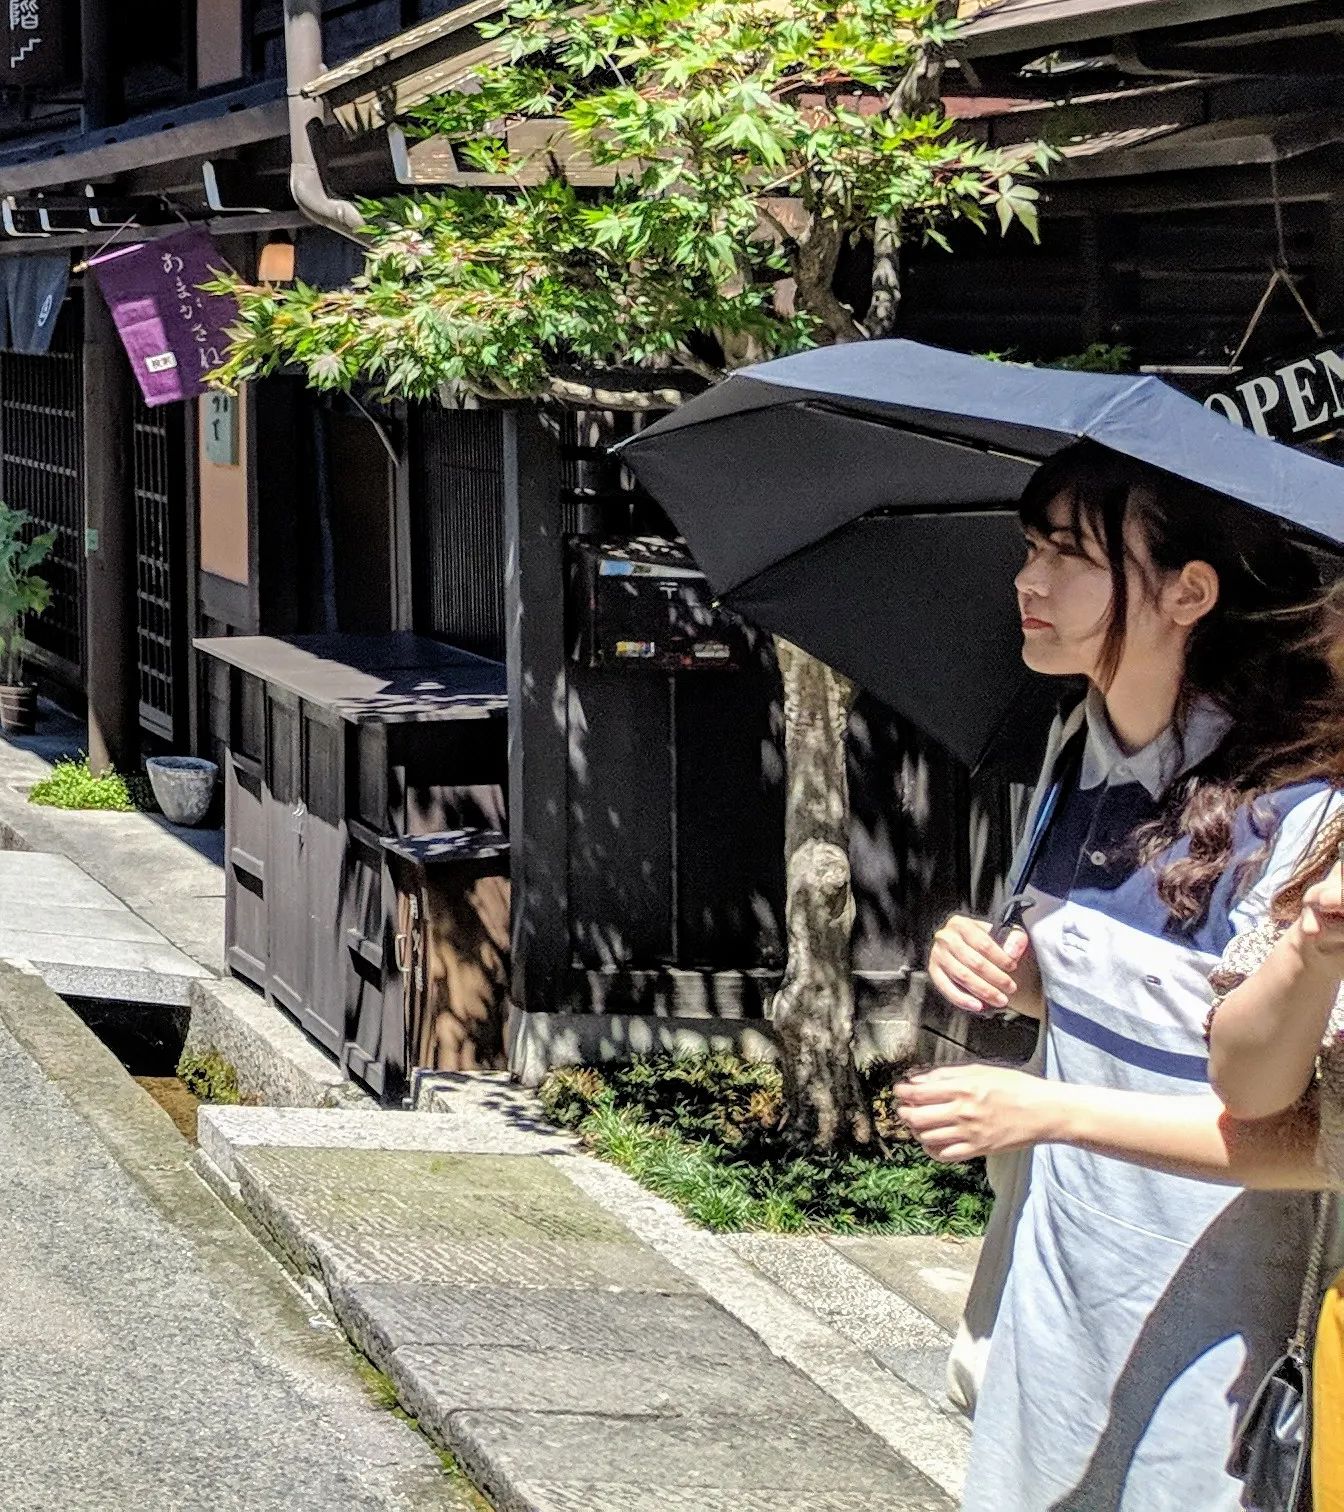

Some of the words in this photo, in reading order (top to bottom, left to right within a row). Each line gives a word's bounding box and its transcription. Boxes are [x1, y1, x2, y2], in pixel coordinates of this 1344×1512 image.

[161, 252, 224, 369] あまがさね
